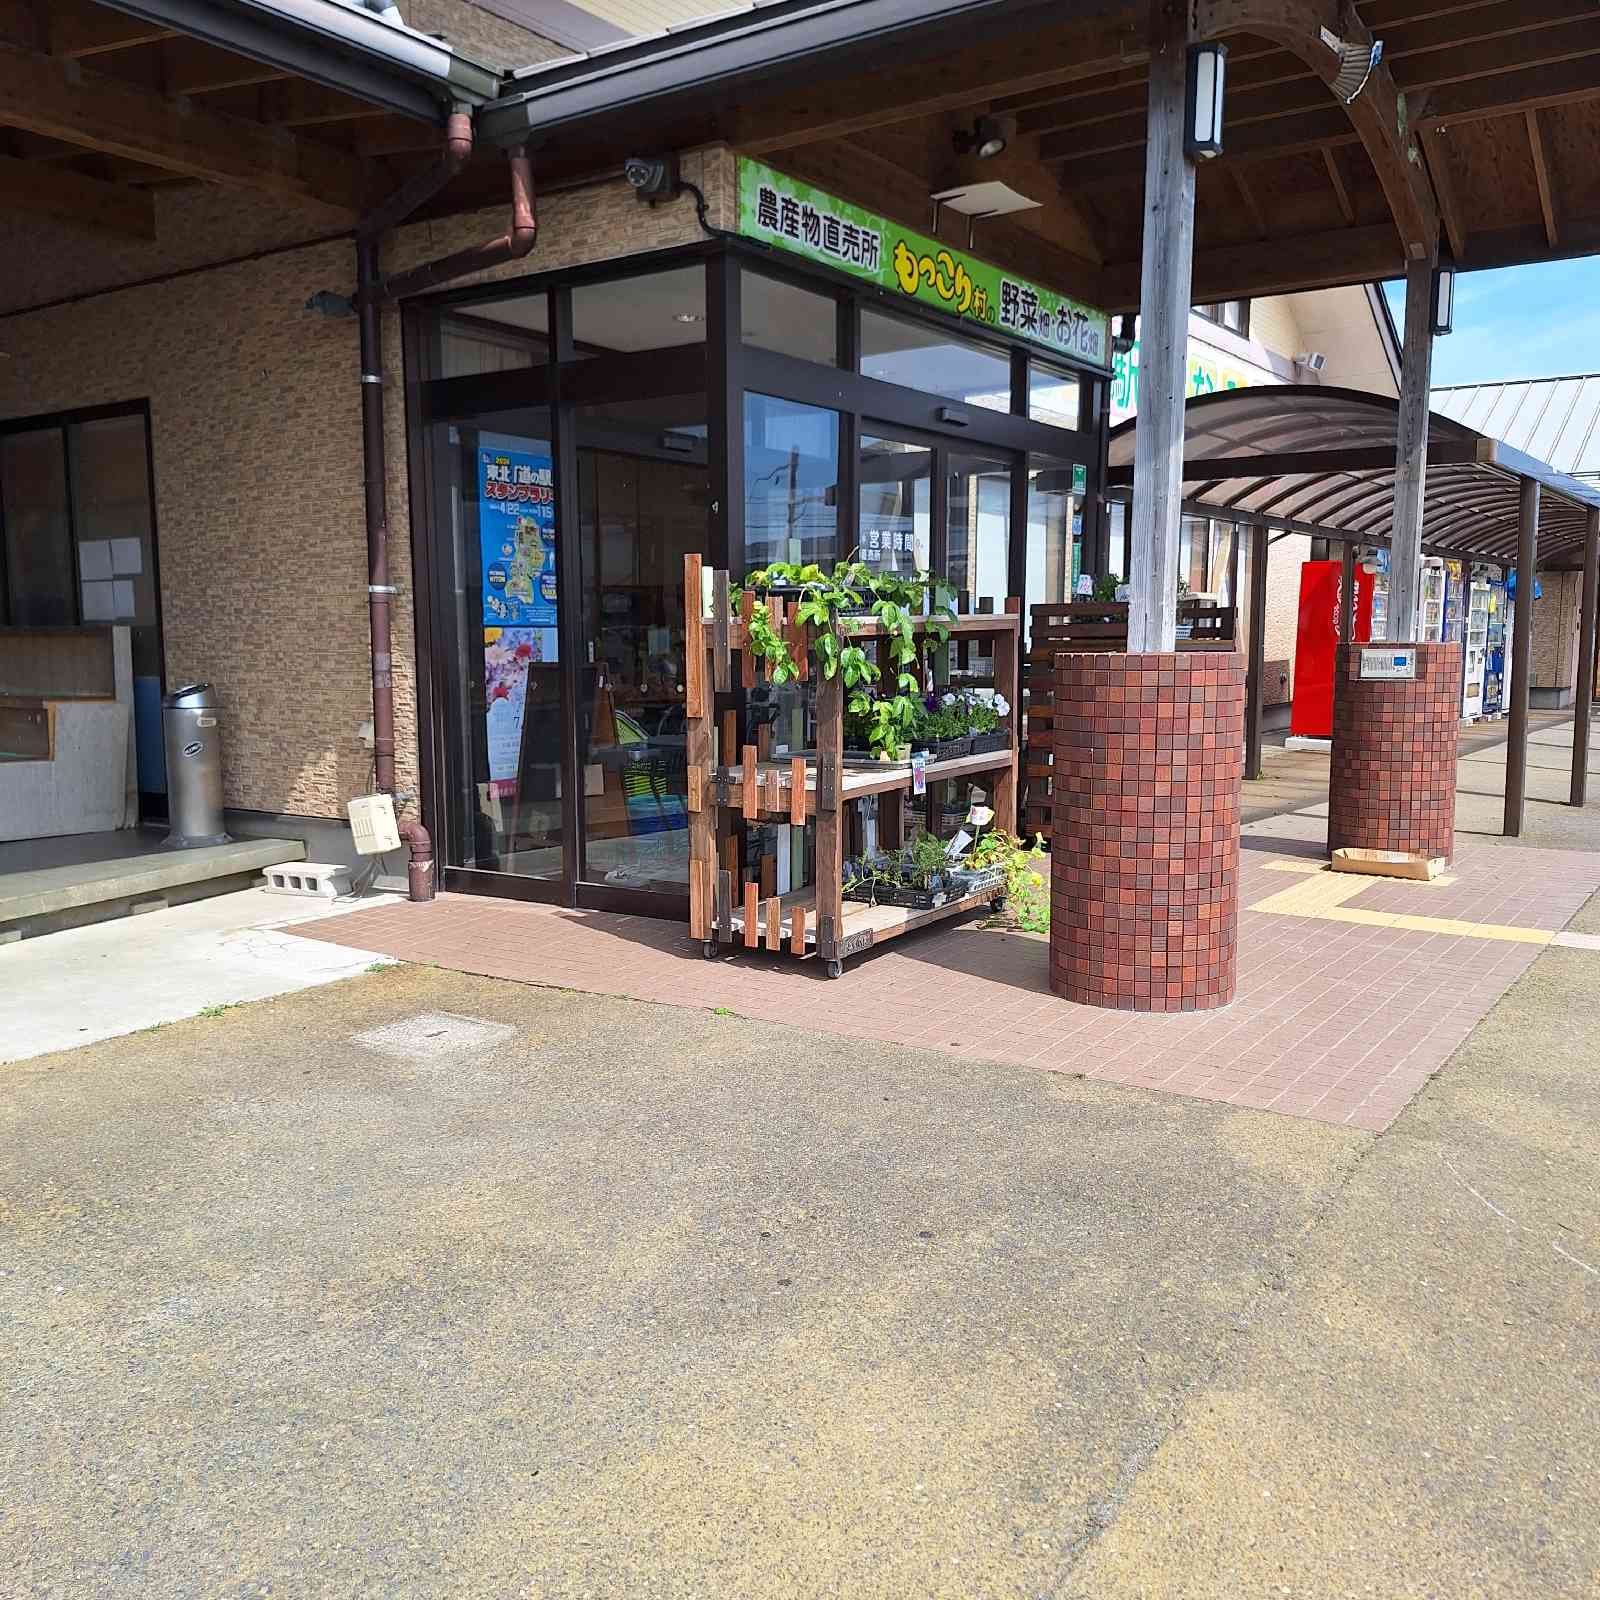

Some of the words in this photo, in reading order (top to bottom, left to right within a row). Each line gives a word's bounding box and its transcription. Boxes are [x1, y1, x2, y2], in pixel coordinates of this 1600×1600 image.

[758, 186, 878, 270] 農産物直売所
[485, 481, 554, 505] スタンプラリ
[870, 529, 914, 551] 営業時間
